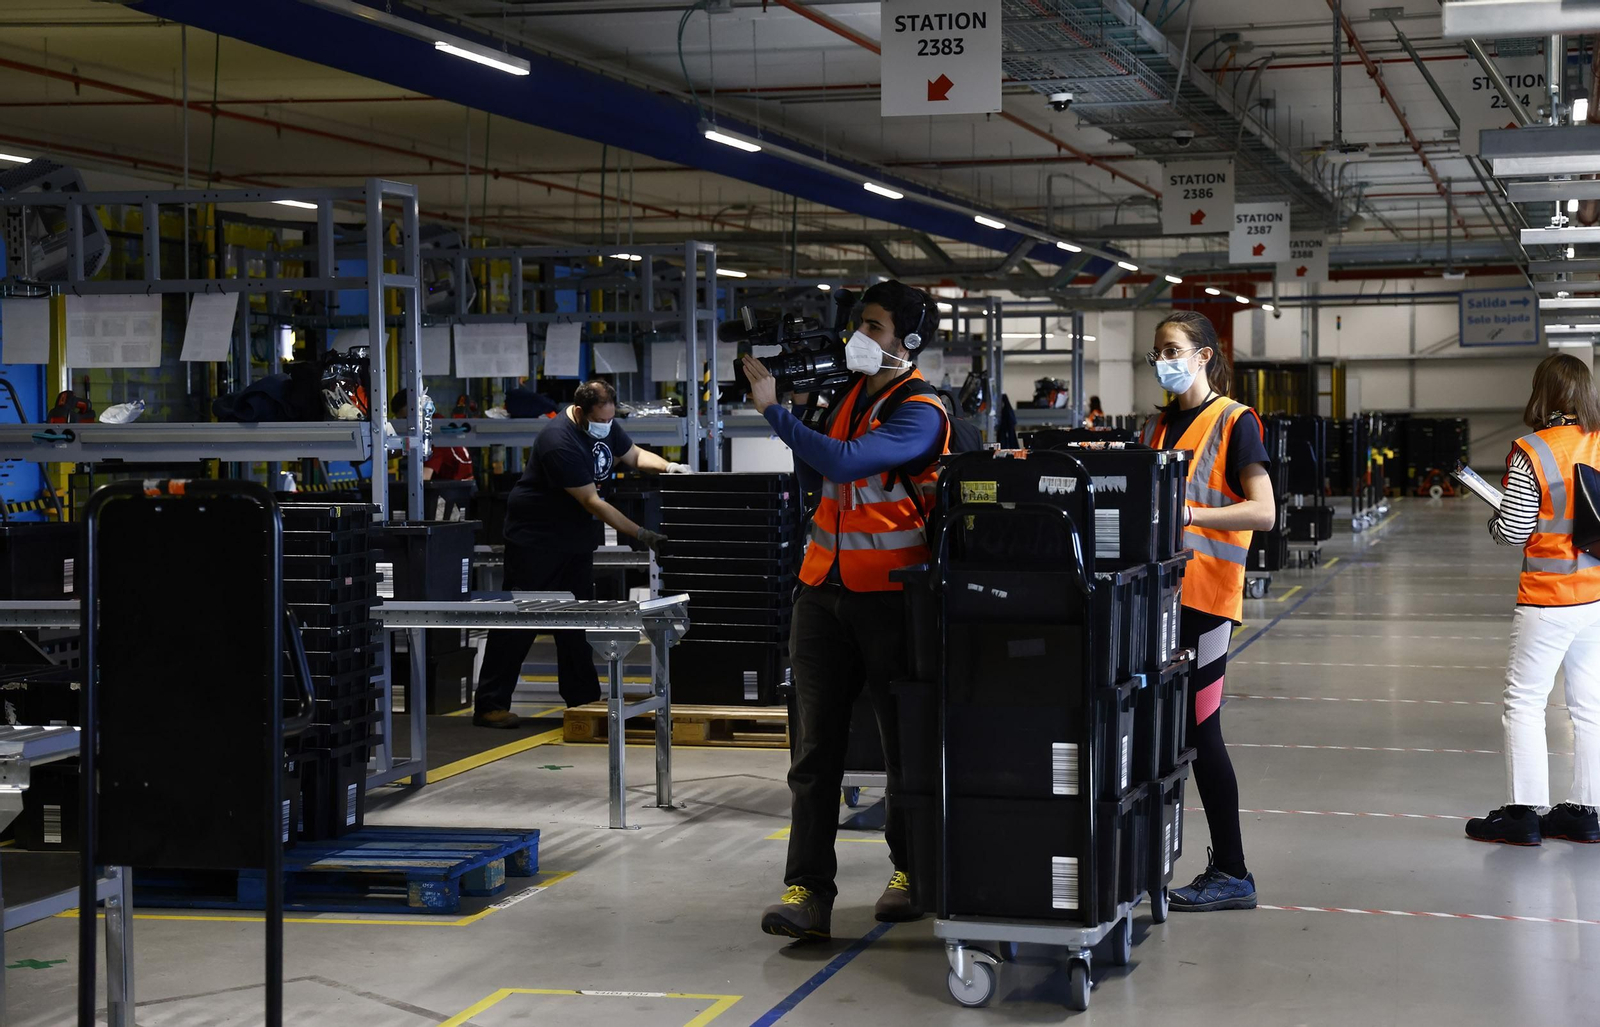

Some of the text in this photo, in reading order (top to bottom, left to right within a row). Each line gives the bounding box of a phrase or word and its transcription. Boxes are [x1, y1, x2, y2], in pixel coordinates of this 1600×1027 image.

[894, 11, 987, 33] STATION
[917, 37, 965, 56] 2383
[1472, 74, 1546, 91] STTION
[1490, 94, 1531, 109] 24
[1170, 173, 1226, 186] STATION
[1183, 188, 1214, 200] 2386
[1236, 213, 1283, 223] STATION
[1246, 225, 1273, 235] 2387
[1290, 240, 1323, 248] TATION
[1291, 250, 1314, 259] 2388
[1467, 296, 1507, 309] Salida
[1467, 313, 1531, 325] Solo bajada
